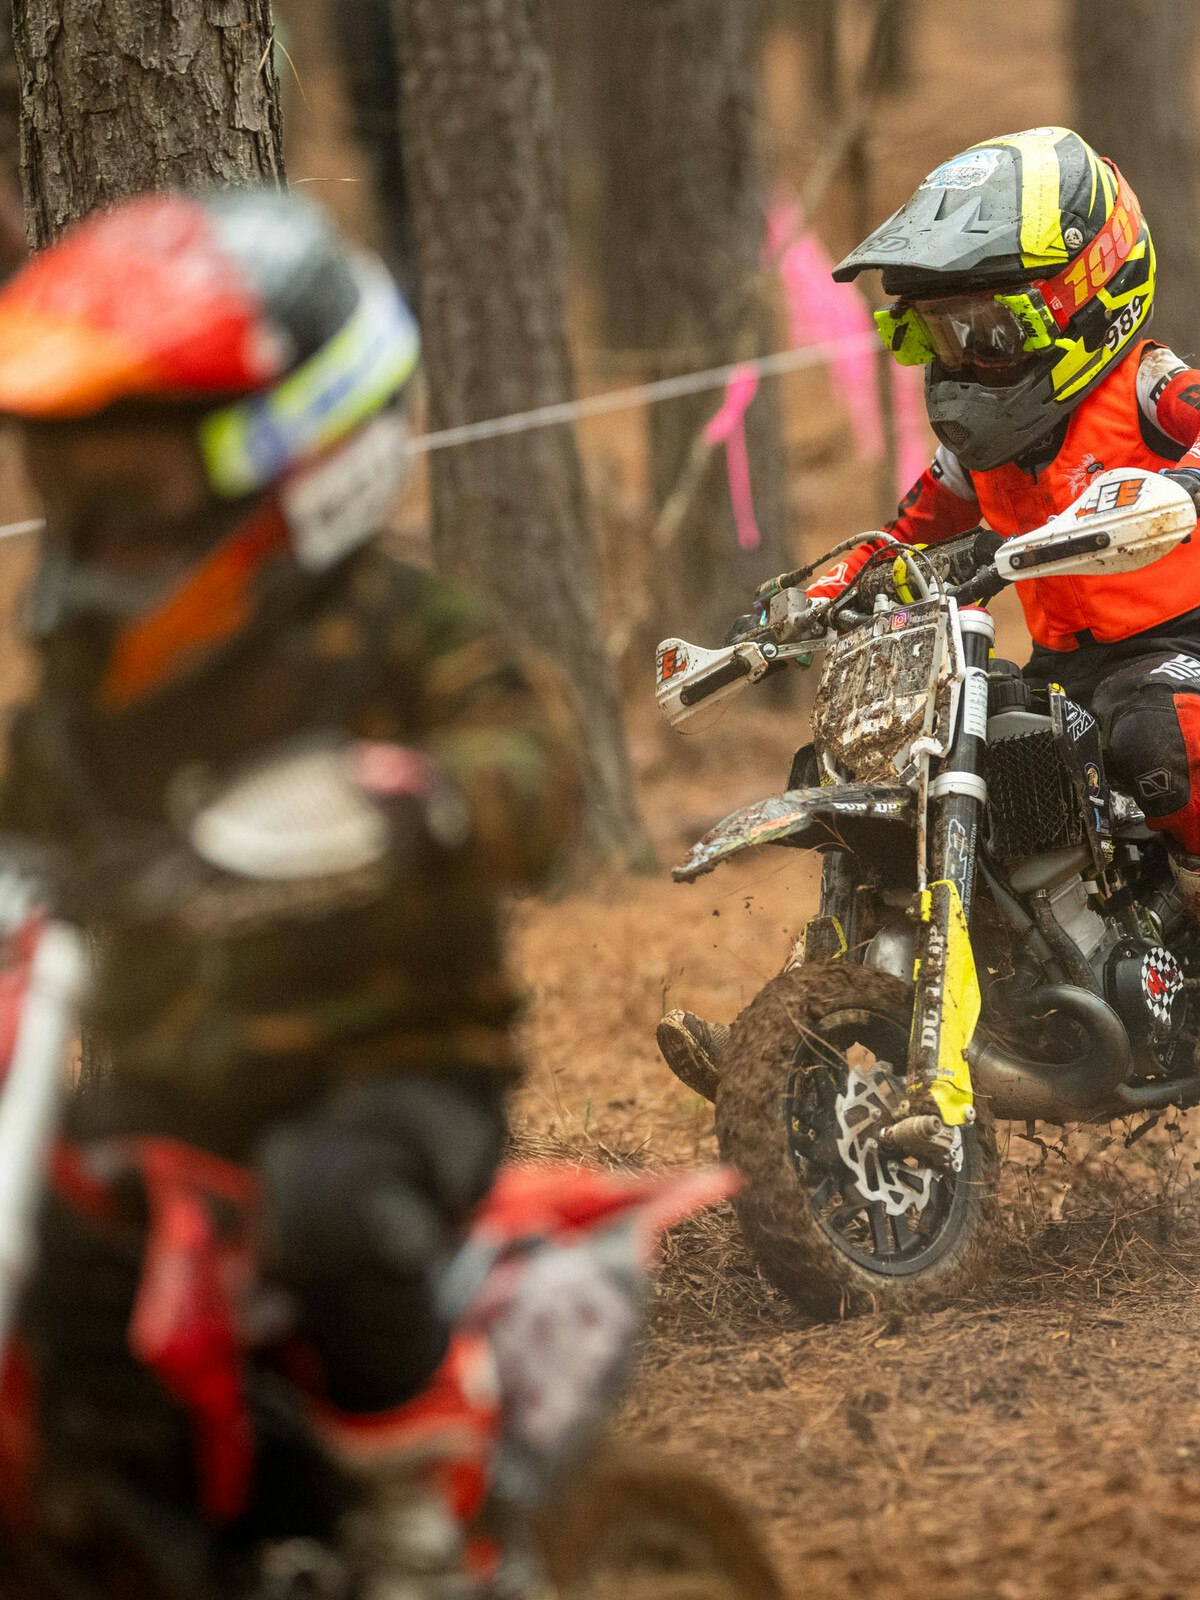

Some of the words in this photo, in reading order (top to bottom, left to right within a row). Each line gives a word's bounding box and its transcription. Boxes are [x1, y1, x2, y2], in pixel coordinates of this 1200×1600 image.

[1104, 295, 1143, 352] 989
[833, 802, 897, 813] DUNOP
[969, 823, 977, 853] SYSTEM
[964, 853, 975, 905] SUSPENSION
